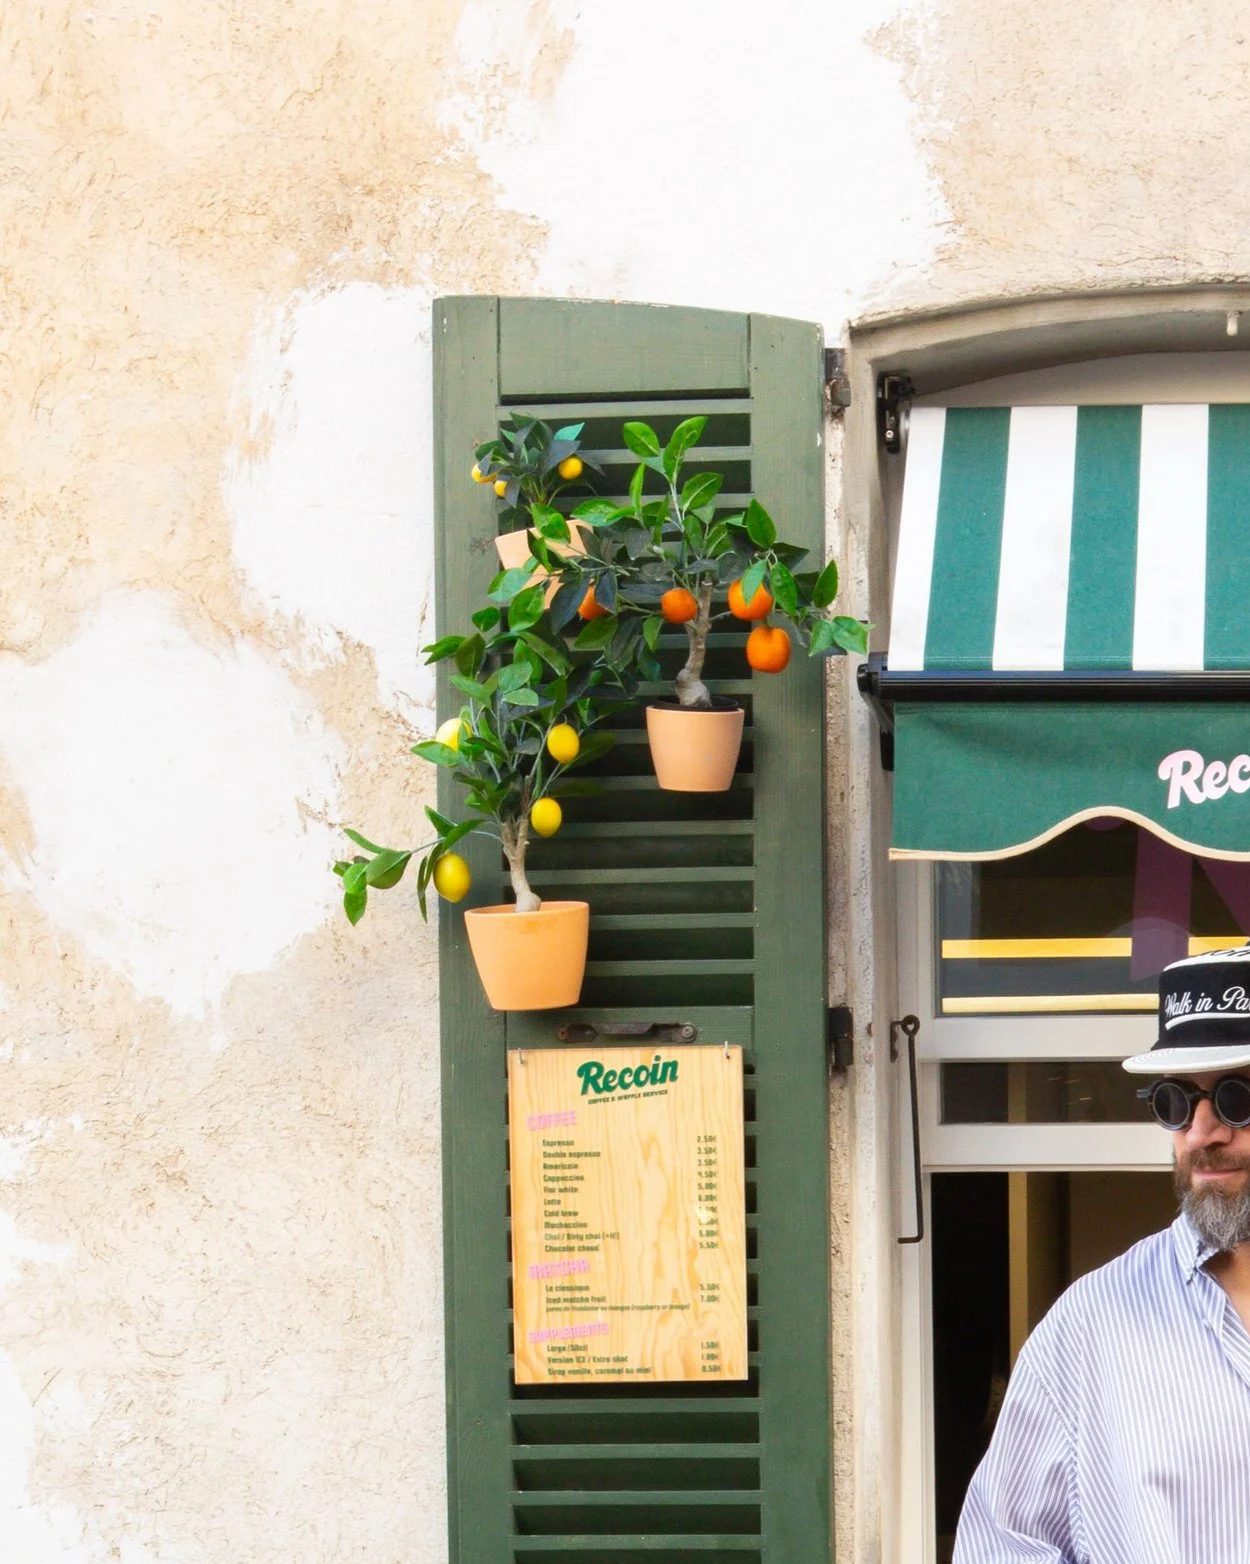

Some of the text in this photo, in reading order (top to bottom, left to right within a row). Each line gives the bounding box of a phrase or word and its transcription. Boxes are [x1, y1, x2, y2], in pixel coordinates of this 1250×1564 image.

[1165, 992, 1193, 1017] Walk
[1195, 992, 1214, 1012] in
[577, 1054, 679, 1096] Recoin
[542, 1138, 575, 1148] Espresso
[543, 1150, 601, 1160] Double espresso
[543, 1173, 584, 1184] Cappuccino
[558, 1186, 579, 1194] white
[544, 1198, 561, 1206] Latte
[544, 1209, 579, 1218] Cold brew
[547, 1344, 567, 1354] Large
